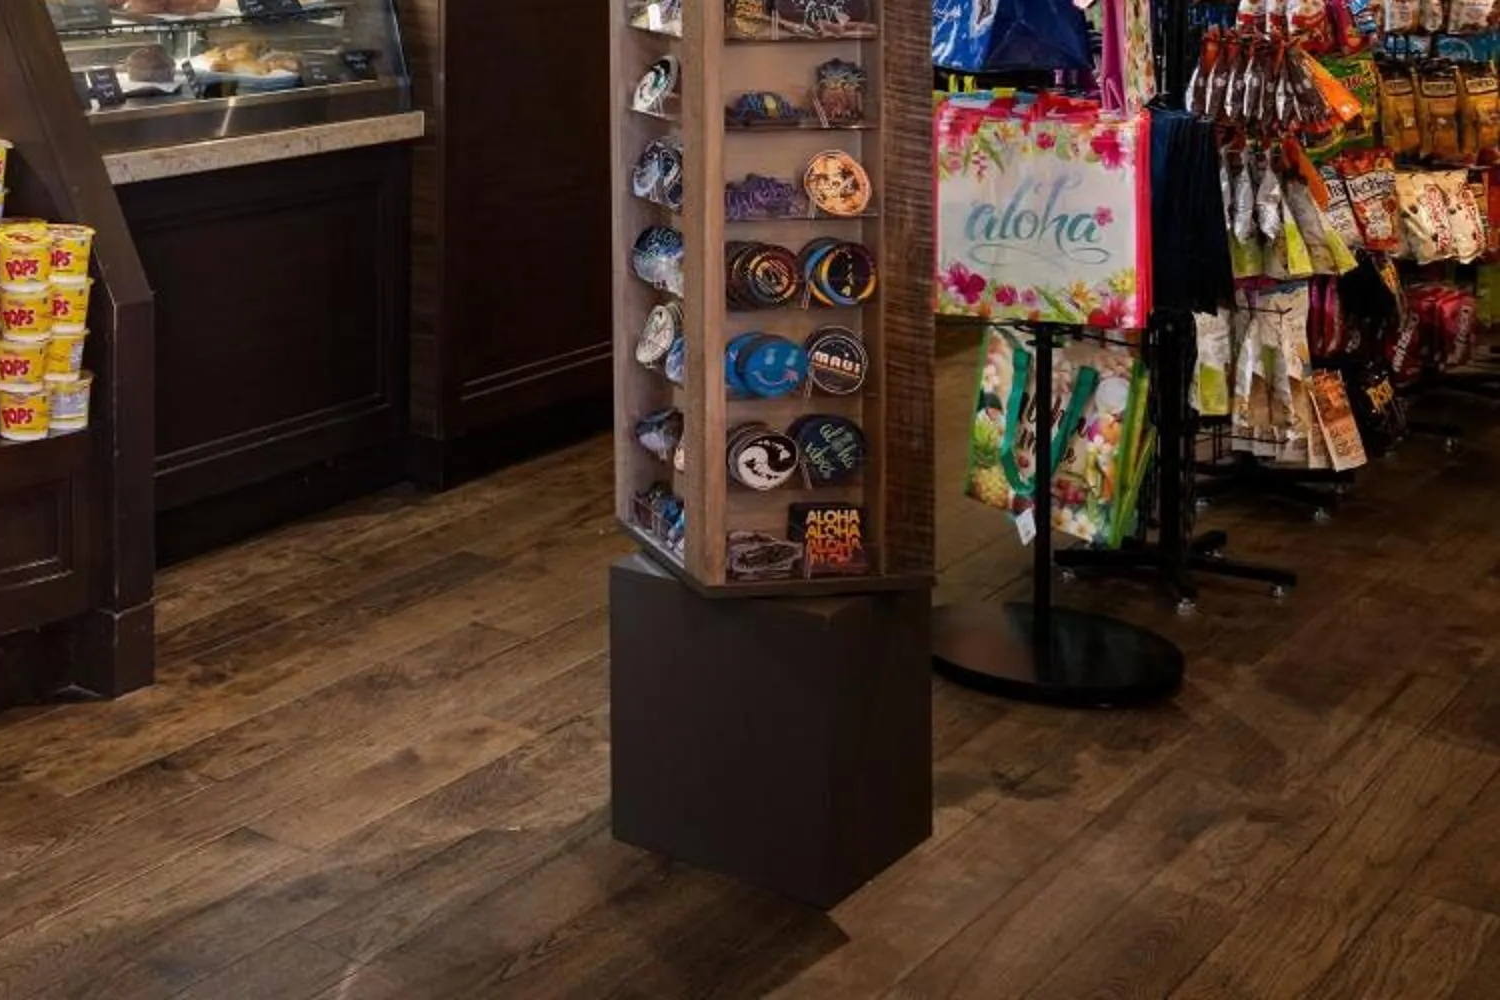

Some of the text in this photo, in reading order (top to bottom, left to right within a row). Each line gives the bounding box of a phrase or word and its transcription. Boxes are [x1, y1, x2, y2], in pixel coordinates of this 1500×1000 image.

[964, 172, 1104, 250] aloha
[5, 259, 39, 280] POPS
[3, 309, 35, 330] POPS
[2, 408, 35, 428] POPS
[805, 509, 861, 524] ALOHA
[805, 524, 861, 538] ALOHA
